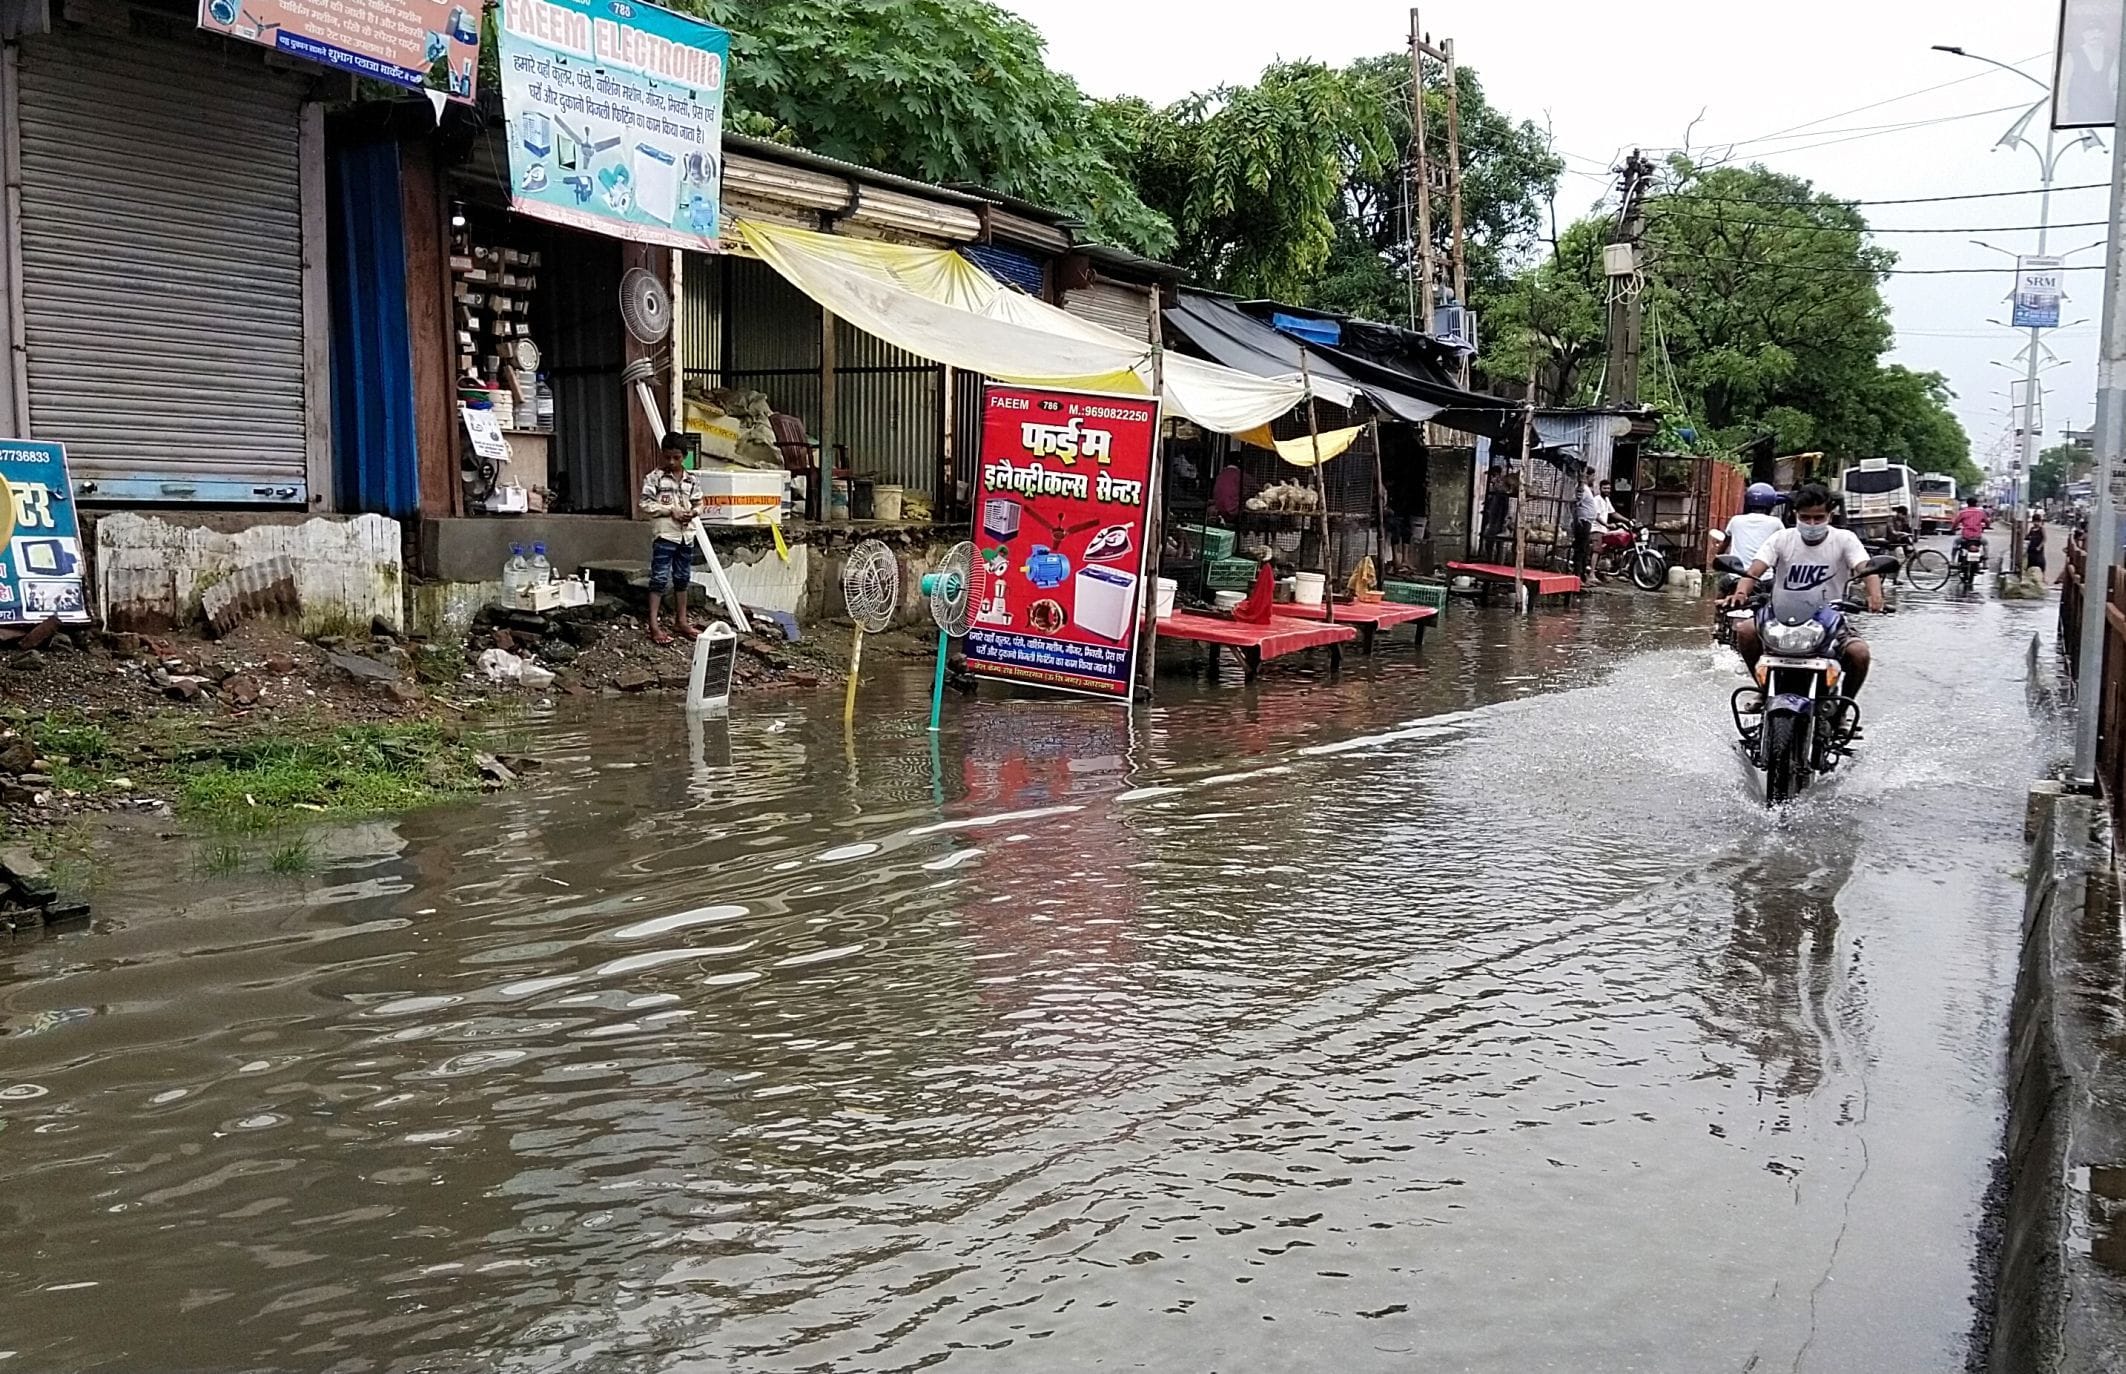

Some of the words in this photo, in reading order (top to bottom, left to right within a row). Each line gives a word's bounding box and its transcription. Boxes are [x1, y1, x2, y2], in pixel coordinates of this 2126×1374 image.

[506, 0, 587, 51] FAEEM
[595, 18, 721, 89] ELECTRONIC
[513, 54, 535, 74] हमारे
[596, 76, 620, 97] वाशिंग
[544, 85, 558, 105] और
[636, 113, 645, 128] का
[646, 116, 660, 132] काम
[662, 116, 678, 137] किया
[680, 125, 694, 142] जाता
[2026, 276, 2056, 287] SRM
[991, 396, 1029, 410] FAEEM
[1043, 401, 1058, 410] 786
[1068, 404, 1148, 422] M.:9690822250
[0, 449, 50, 463] 7736833
[1020, 417, 1112, 465] फईम
[1096, 469, 1143, 505] सेन्टर
[1788, 565, 1829, 583] NIKE
